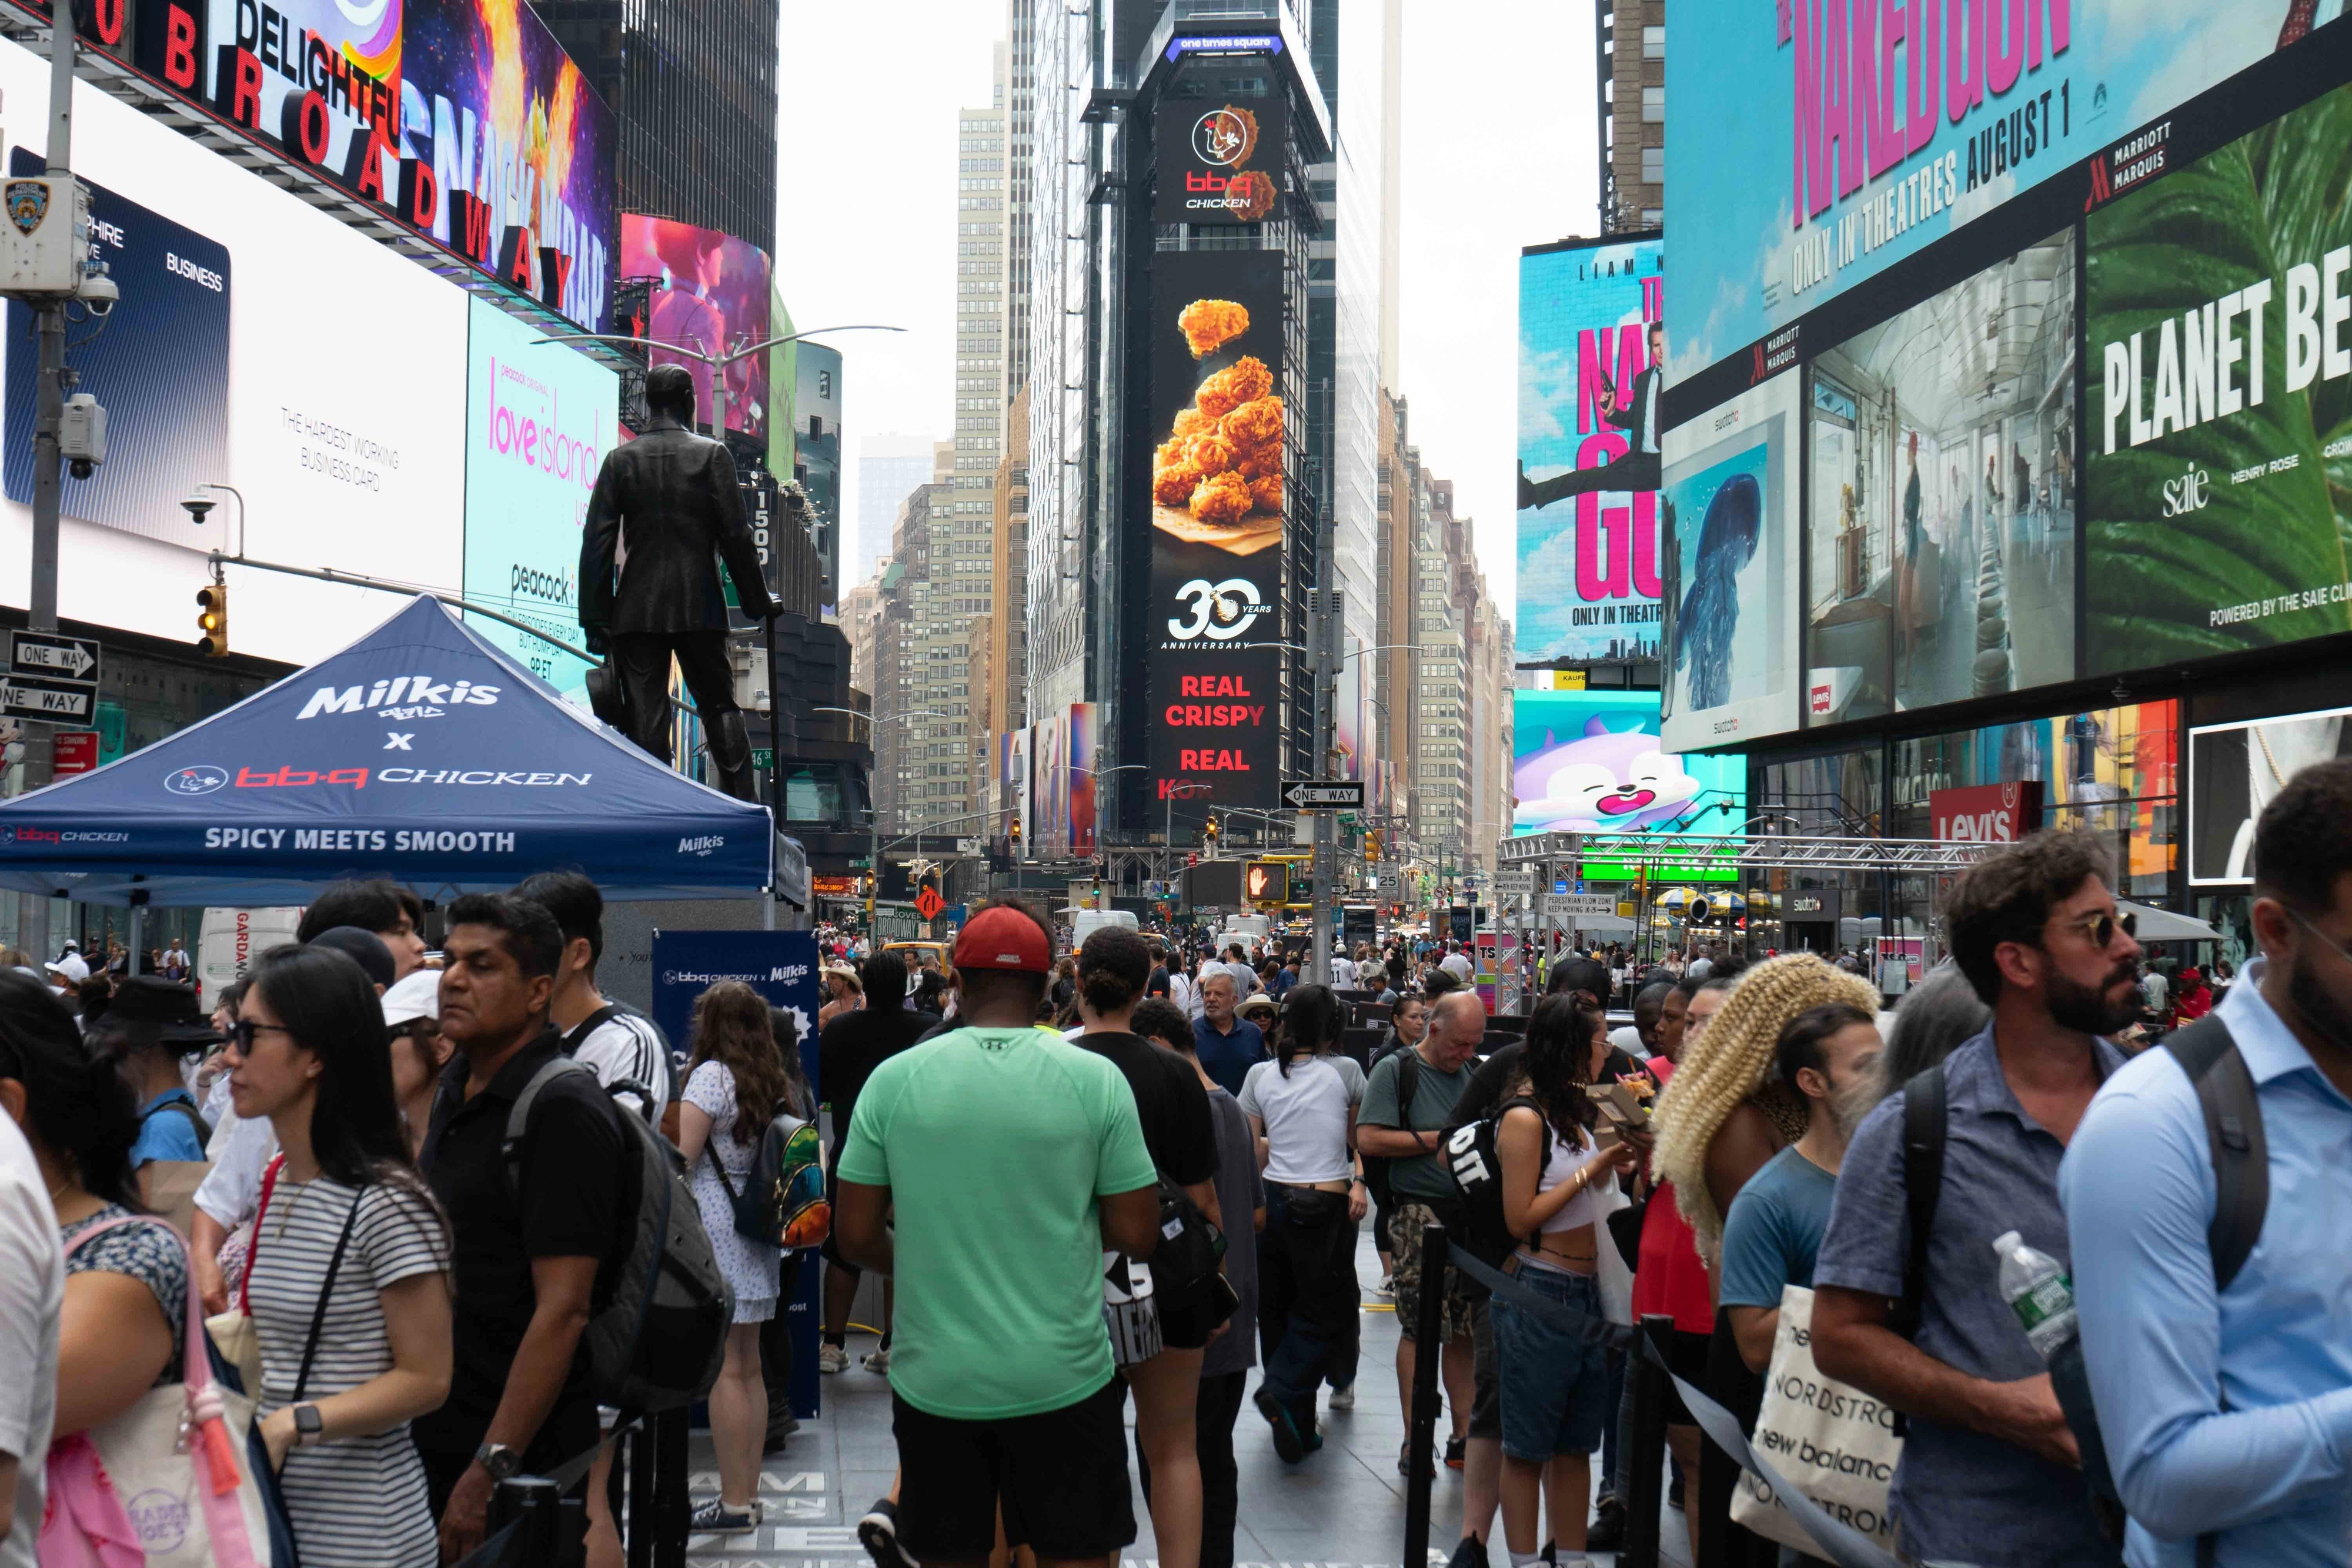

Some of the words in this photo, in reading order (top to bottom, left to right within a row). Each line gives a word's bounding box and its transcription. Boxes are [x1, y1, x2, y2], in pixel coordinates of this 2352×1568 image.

[1181, 39, 1201, 48] one
[1202, 39, 1232, 47] times
[1234, 38, 1270, 48] square
[2115, 122, 2171, 166] MARRIOTT
[165, 3, 573, 309] BROADWAY
[2115, 151, 2164, 189] MARQUIS
[1793, 227, 1831, 295] ONLY
[1838, 212, 1856, 270] IN
[1863, 149, 1957, 255] THEATRES
[1967, 89, 2052, 194] AUGUST
[2062, 78, 2070, 138] 1
[1186, 199, 1250, 209] CHICKEN
[167, 252, 222, 292] BUSINESS
[1579, 259, 1633, 281] LIAM
[1767, 326, 1800, 353] MARRIOTT
[1767, 346, 1796, 372] MARQUIS
[2104, 279, 2271, 456] PLANET
[501, 364, 526, 385] peacock
[489, 356, 537, 466] love
[540, 388, 597, 490] island
[281, 407, 302, 434] THE
[305, 414, 351, 452] HARDEST
[355, 437, 399, 470] WORKING
[301, 447, 350, 483] BUSINESS
[354, 466, 380, 492] CARD
[2231, 464, 2267, 484] HENRY
[2270, 454, 2299, 473] ROSE
[2163, 462, 2209, 517] saie
[756, 492, 769, 565] 1500
[511, 563, 569, 606] peacock
[1168, 579, 1261, 640] 30
[1572, 607, 1599, 626] ONLY
[1604, 606, 1615, 625] IN
[2210, 603, 2260, 627] POWERED
[2263, 599, 2276, 616] BY
[2278, 593, 2299, 613] THE
[2302, 588, 2327, 608] SAIE
[520, 633, 532, 649] BUT
[549, 621, 567, 642] EVERY
[568, 627, 579, 643] DAY
[24, 646, 50, 664] ONE
[61, 651, 86, 668] WAY
[543, 659, 552, 680] ET
[296, 676, 502, 720] Milkis
[1181, 676, 1250, 697] REAL
[42, 692, 79, 711] WAY
[1165, 706, 1265, 726] CRISPY
[1181, 750, 1250, 770] REAL
[378, 768, 593, 785] CHICKEN
[1294, 790, 1317, 800] ONE
[1329, 790, 1353, 800] WAY
[61, 832, 129, 842] CHICKEN
[205, 828, 286, 848] SPICY
[295, 830, 386, 850] MEETS
[395, 831, 514, 852] SMOOTH
[678, 835, 724, 852] Milkis
[1379, 876, 1396, 886] 25
[770, 964, 807, 982] Milkis
